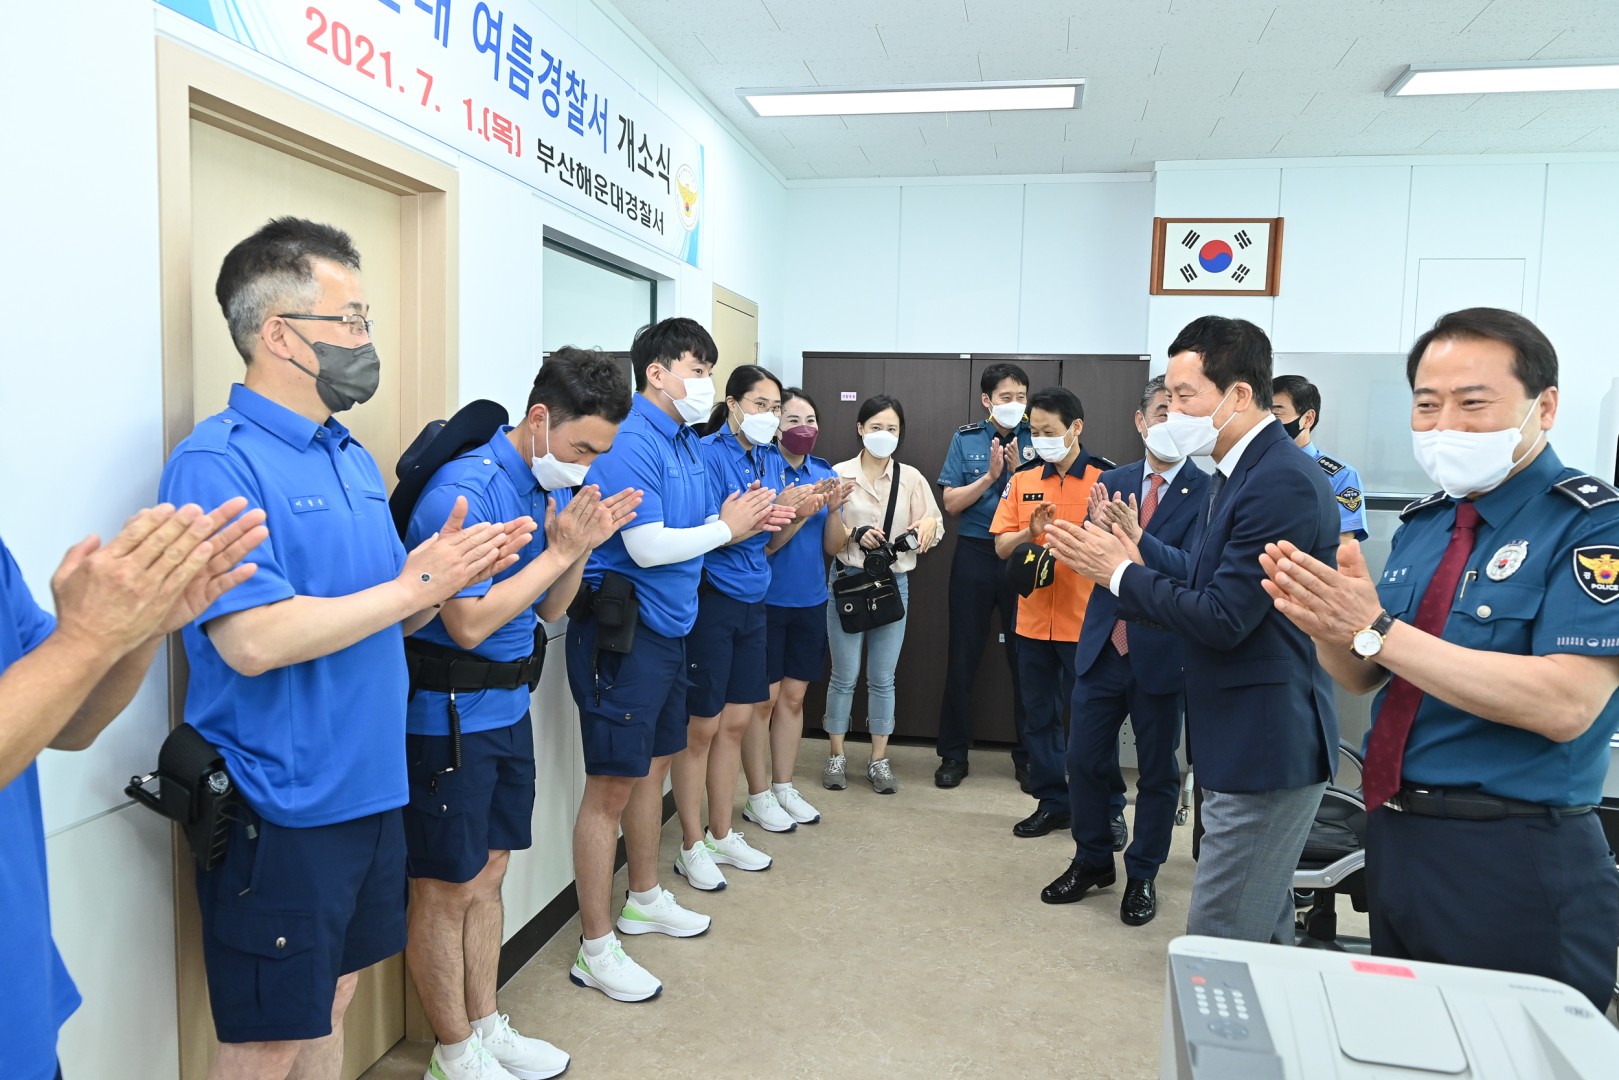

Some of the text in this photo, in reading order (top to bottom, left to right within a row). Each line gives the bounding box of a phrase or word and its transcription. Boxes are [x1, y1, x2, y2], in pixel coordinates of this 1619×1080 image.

[306, 6, 405, 94] 2021.
[473, 2, 608, 154] 여름경찰서
[617, 114, 671, 195] 개소식
[537, 138, 664, 236] 부산해운대경찰서
[1591, 583, 1619, 591] POLICE
